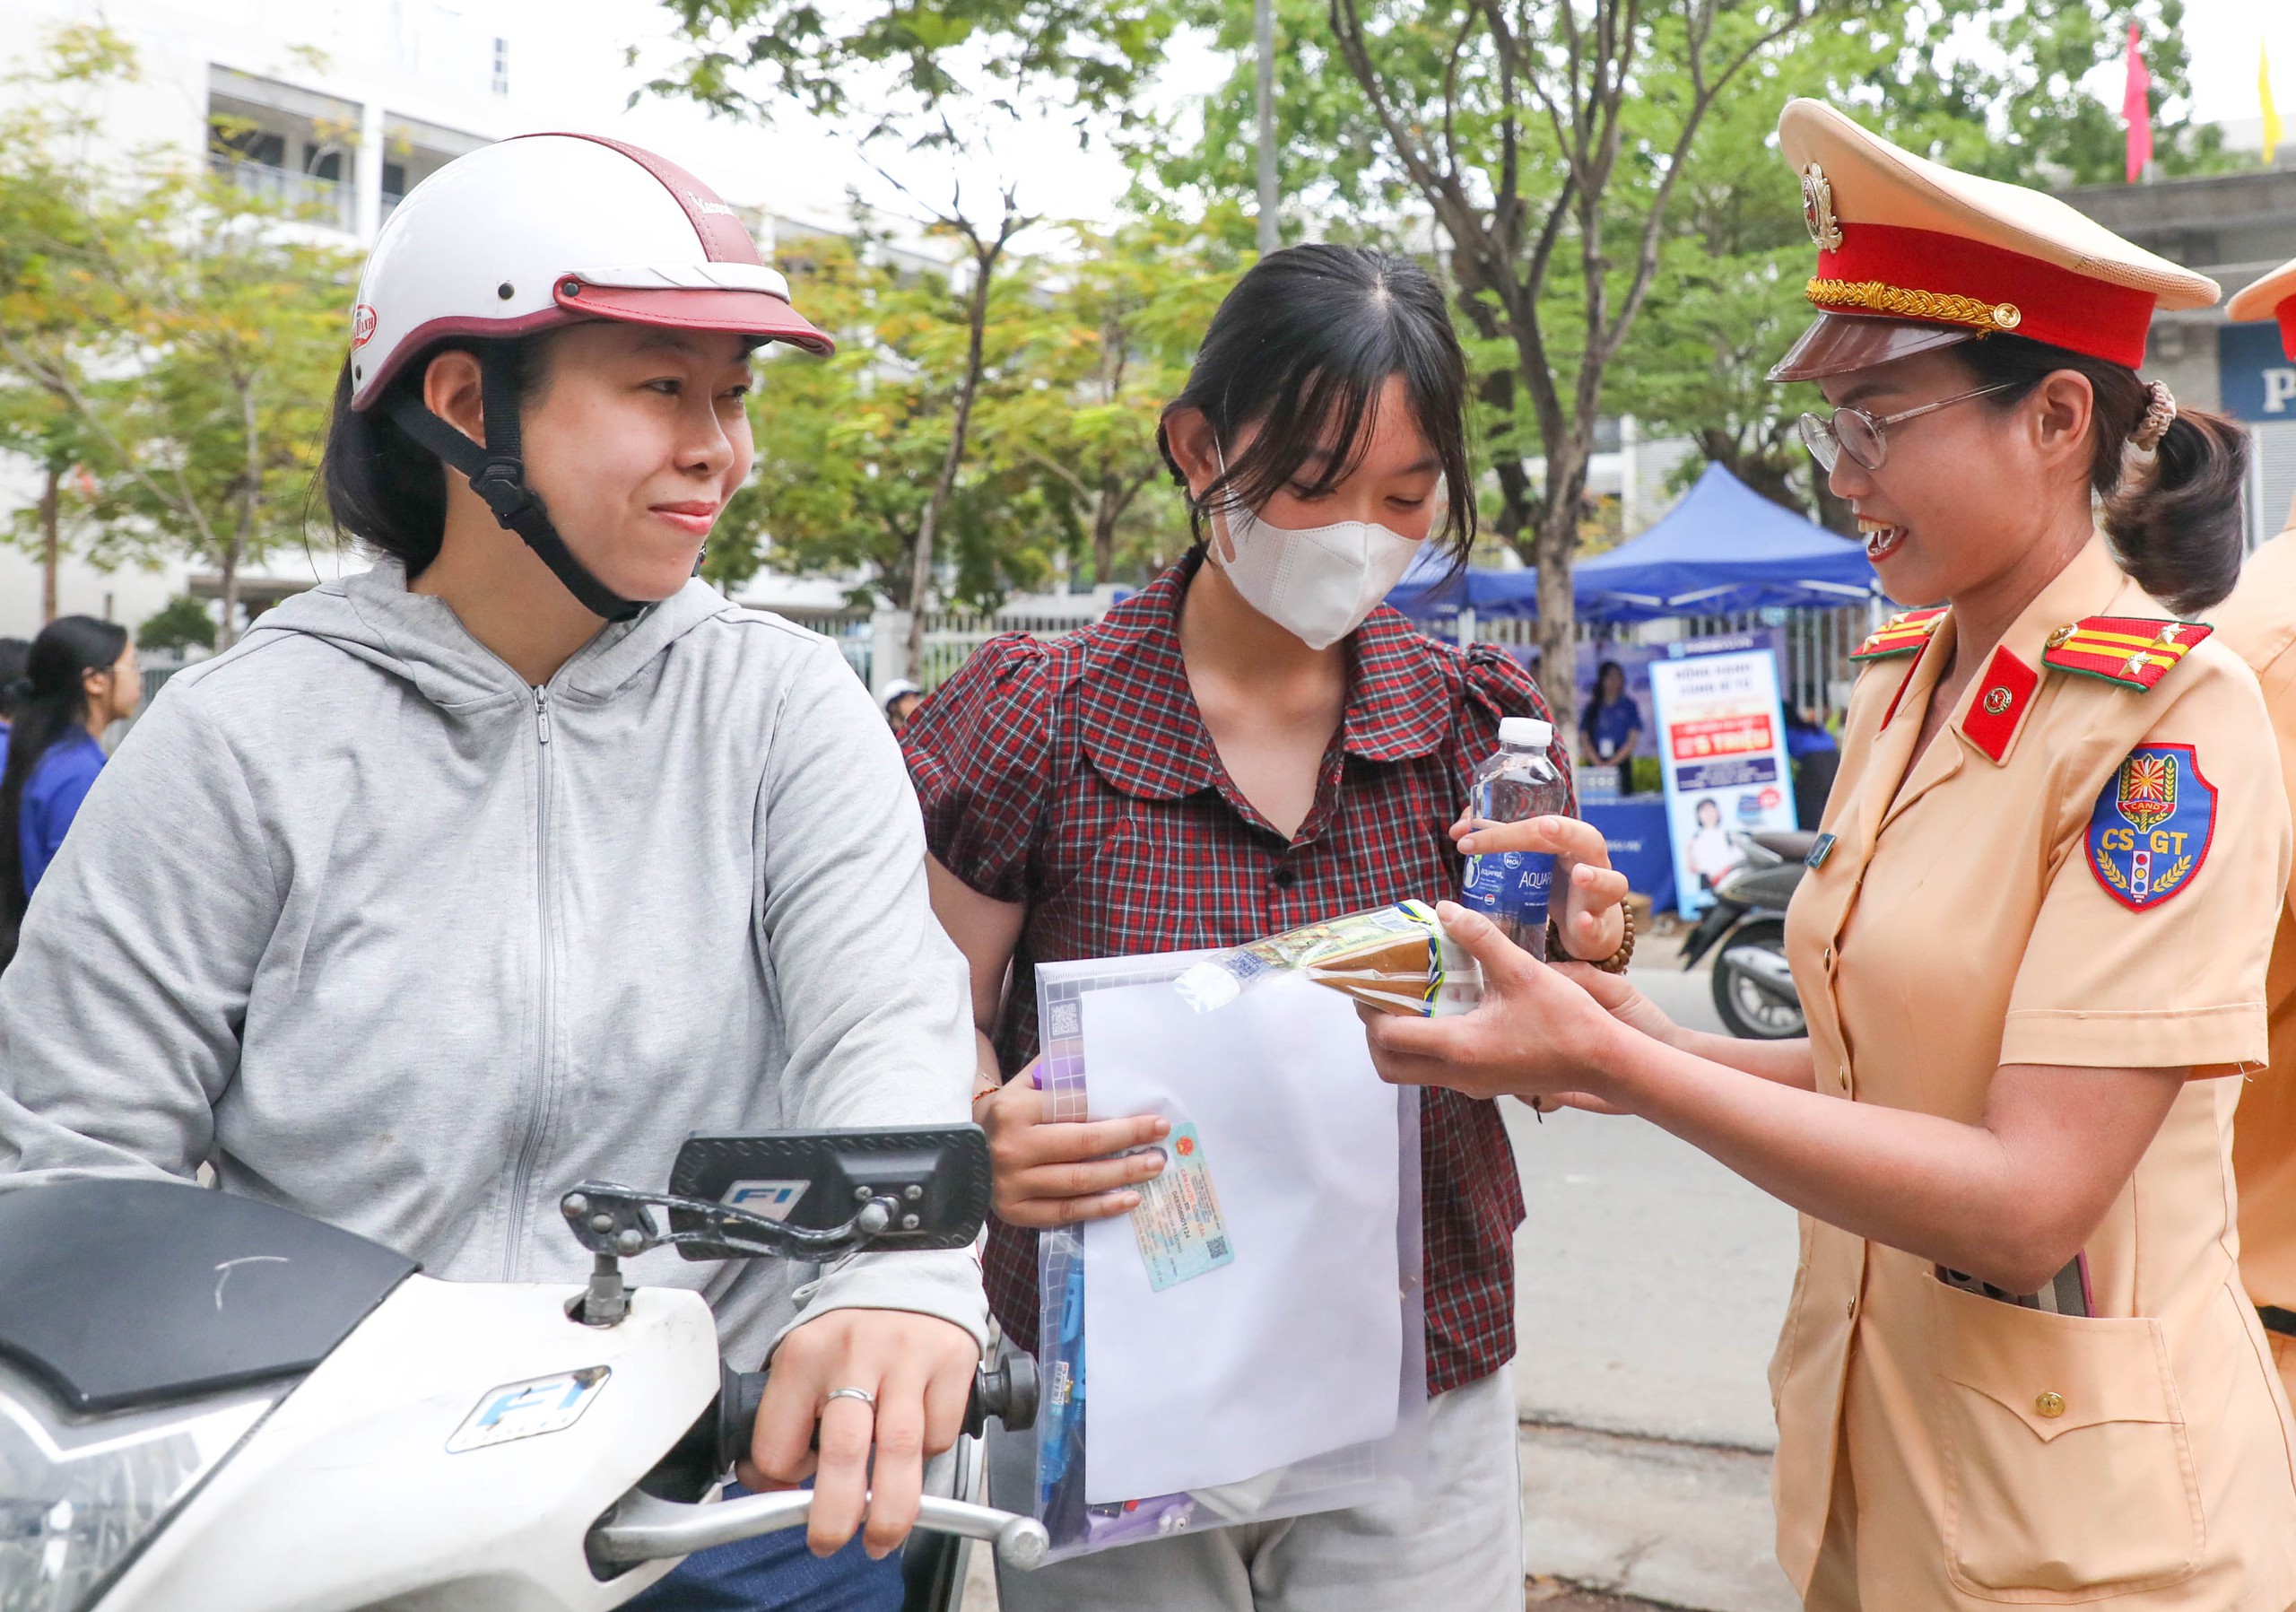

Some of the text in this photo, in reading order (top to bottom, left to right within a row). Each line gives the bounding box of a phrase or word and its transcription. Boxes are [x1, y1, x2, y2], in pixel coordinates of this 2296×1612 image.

[2131, 802, 2161, 811] CAND
[2101, 828, 2188, 855] CS GT
[1179, 1168, 1189, 1182] CĂN
[732, 1189, 793, 1203] FI
